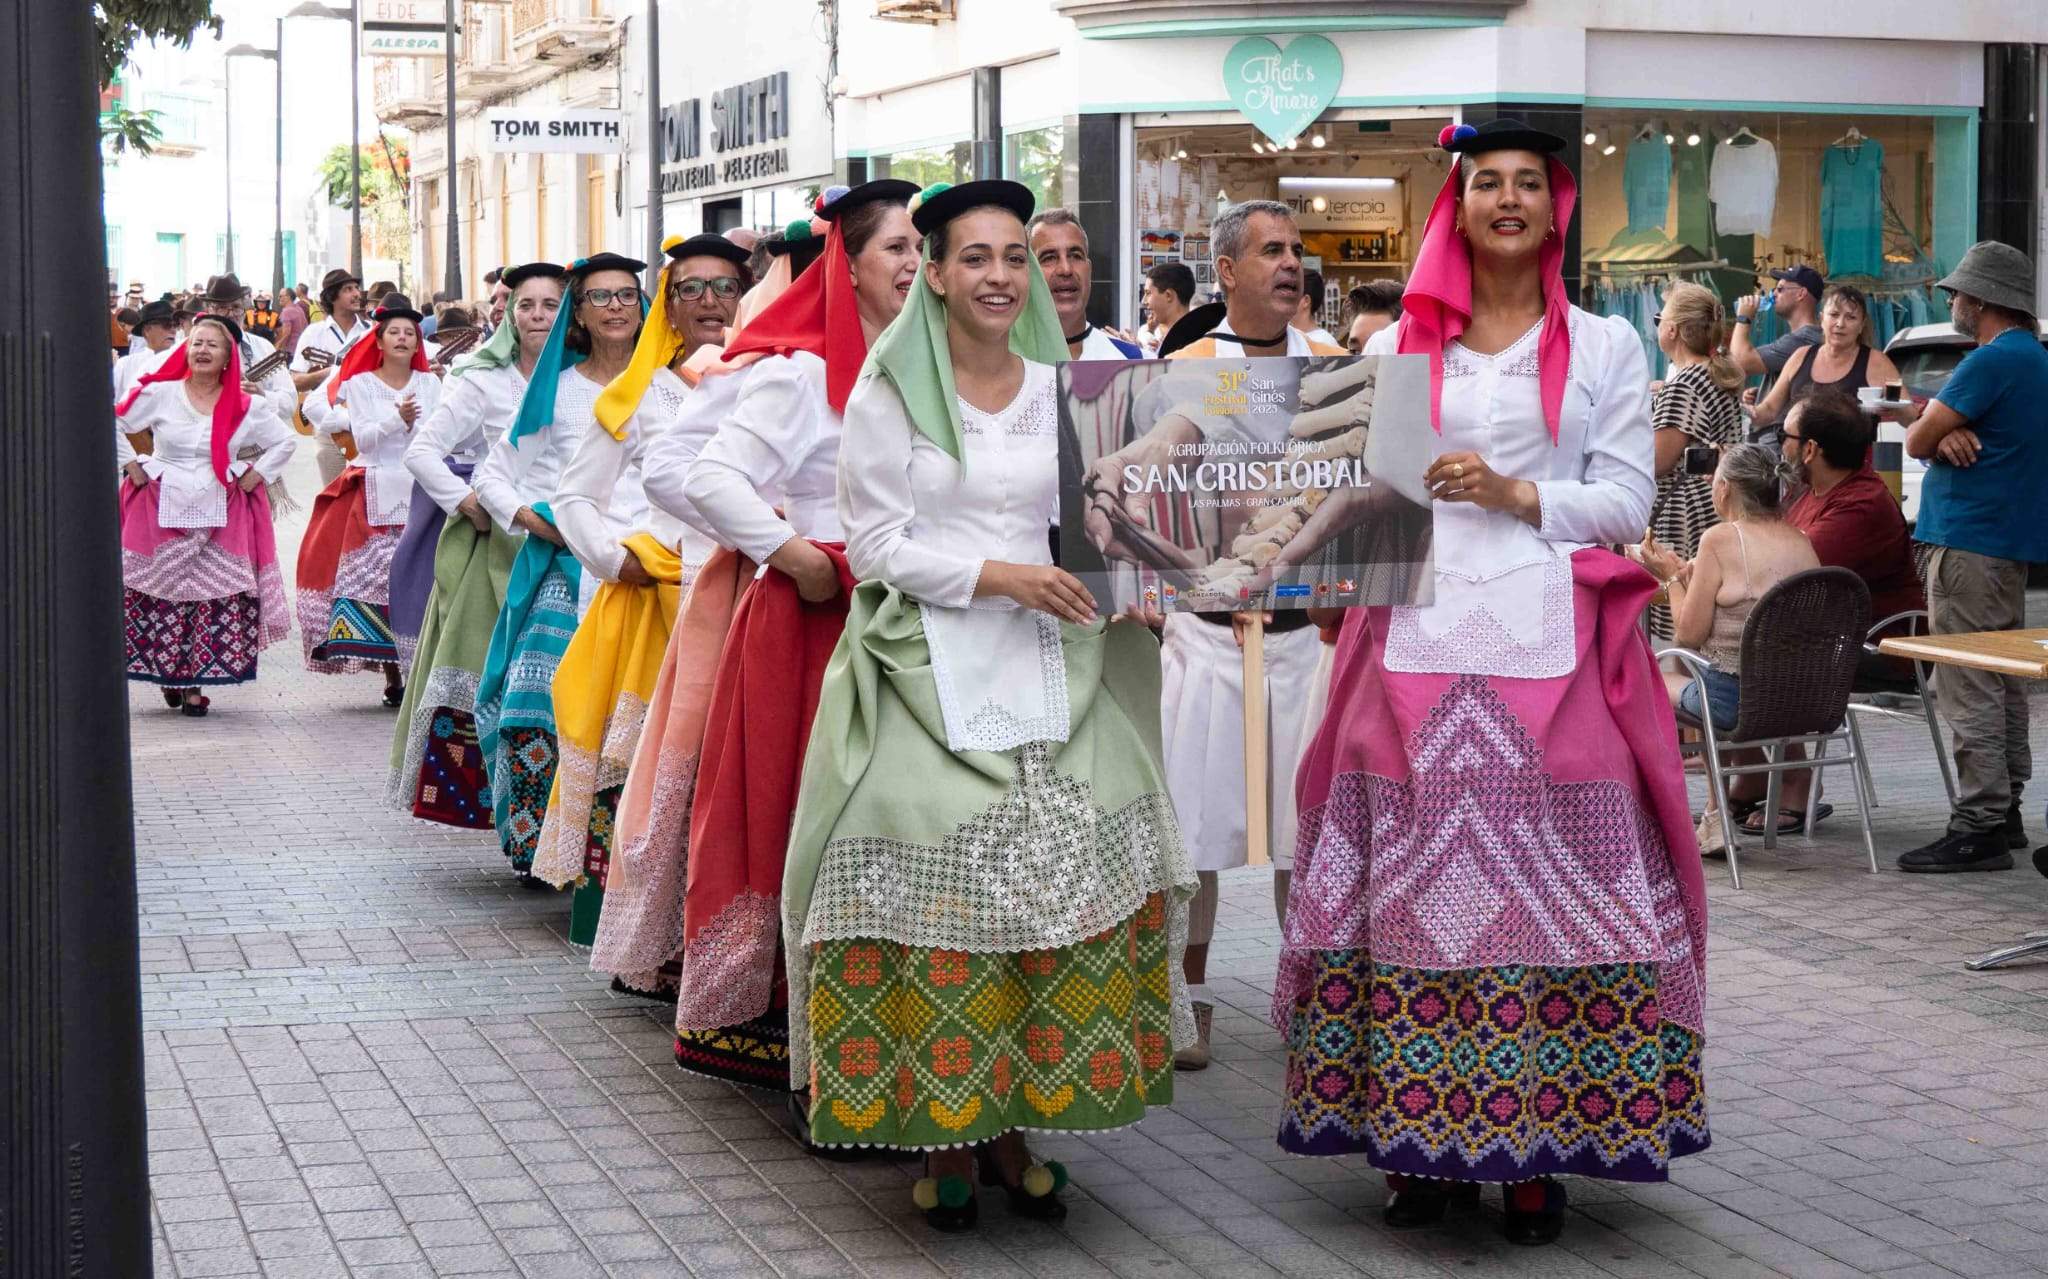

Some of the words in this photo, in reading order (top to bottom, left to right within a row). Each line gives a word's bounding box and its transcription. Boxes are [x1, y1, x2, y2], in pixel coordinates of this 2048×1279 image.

[371, 38, 439, 48] ALESPA
[1245, 85, 1318, 114] Amore
[711, 71, 789, 153] SMITH
[491, 120, 540, 136] TOM
[548, 121, 619, 137] SMITH
[723, 147, 789, 183] PELETERIA
[1251, 377, 1275, 390] San
[1252, 390, 1286, 403] Ginés
[1168, 439, 1248, 457] AGRUPACIÓN
[1250, 437, 1327, 456] FOLKLÓRICA
[1123, 463, 1187, 494] SAN
[1196, 455, 1372, 493] CRISTÓBAL
[1188, 498, 1205, 509] LAS
[1206, 497, 1241, 508] PALMAS
